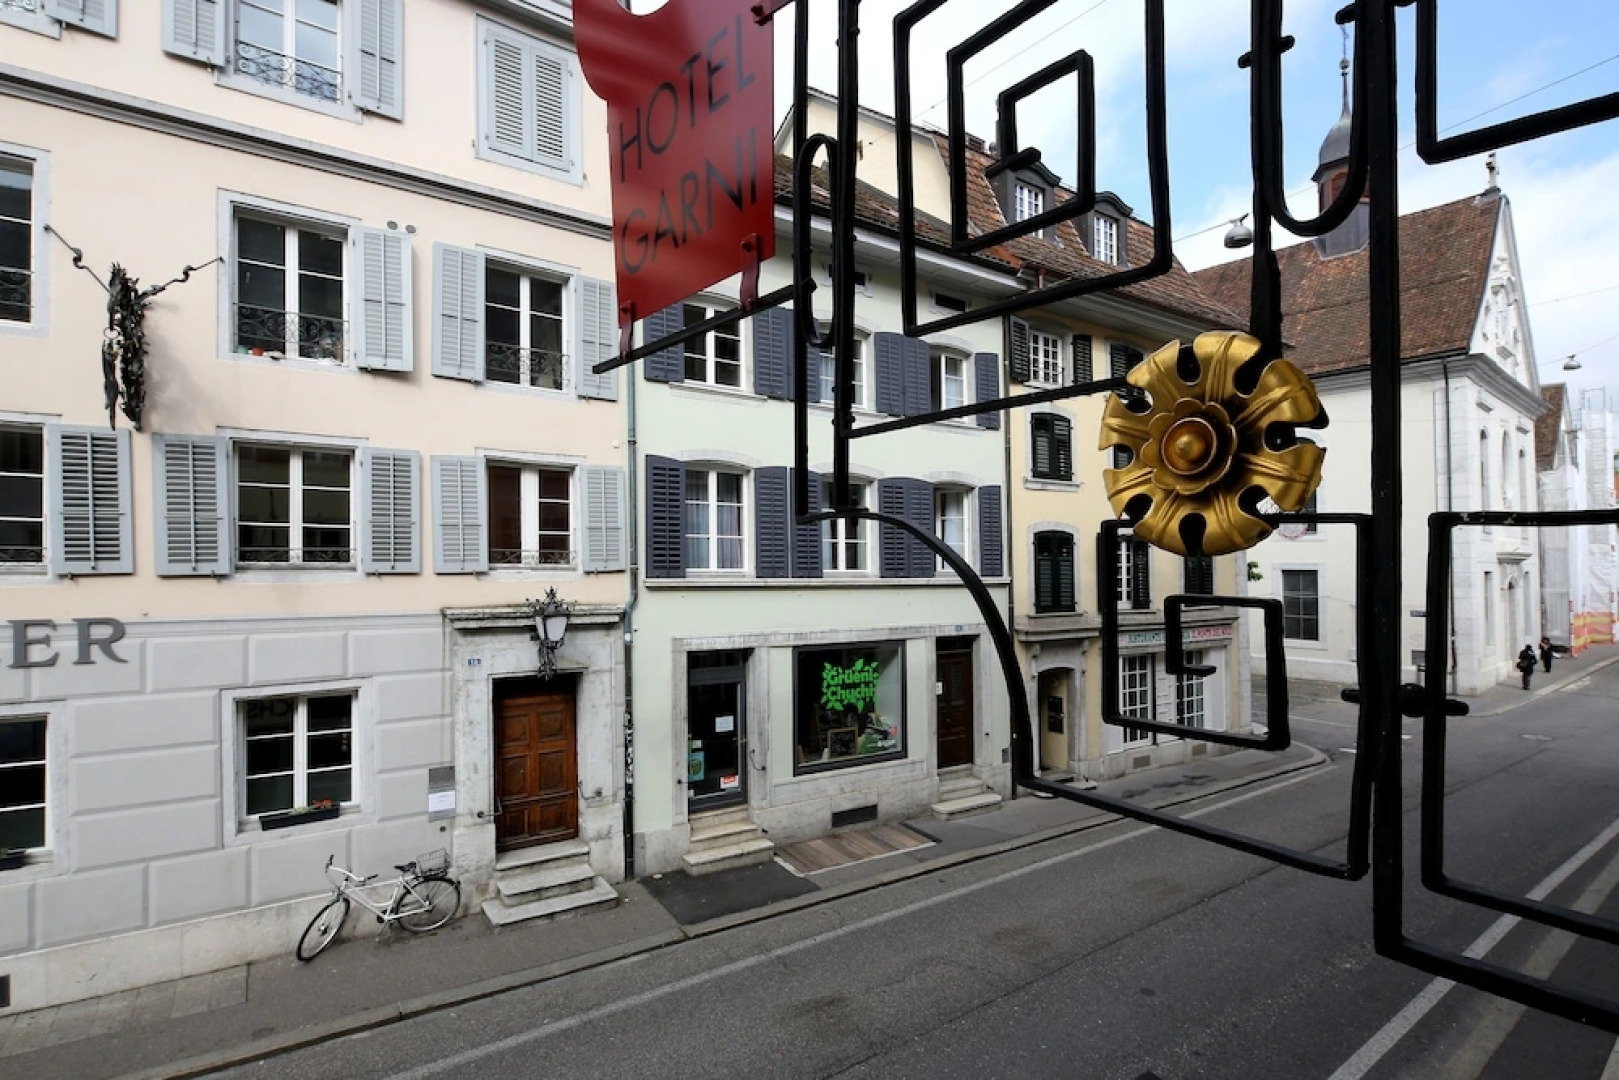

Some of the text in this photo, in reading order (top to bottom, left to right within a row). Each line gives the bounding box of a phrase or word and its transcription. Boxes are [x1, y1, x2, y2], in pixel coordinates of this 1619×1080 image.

[619, 14, 756, 182] HOTEL
[621, 127, 757, 274] GARNI
[0, 617, 128, 669] ER
